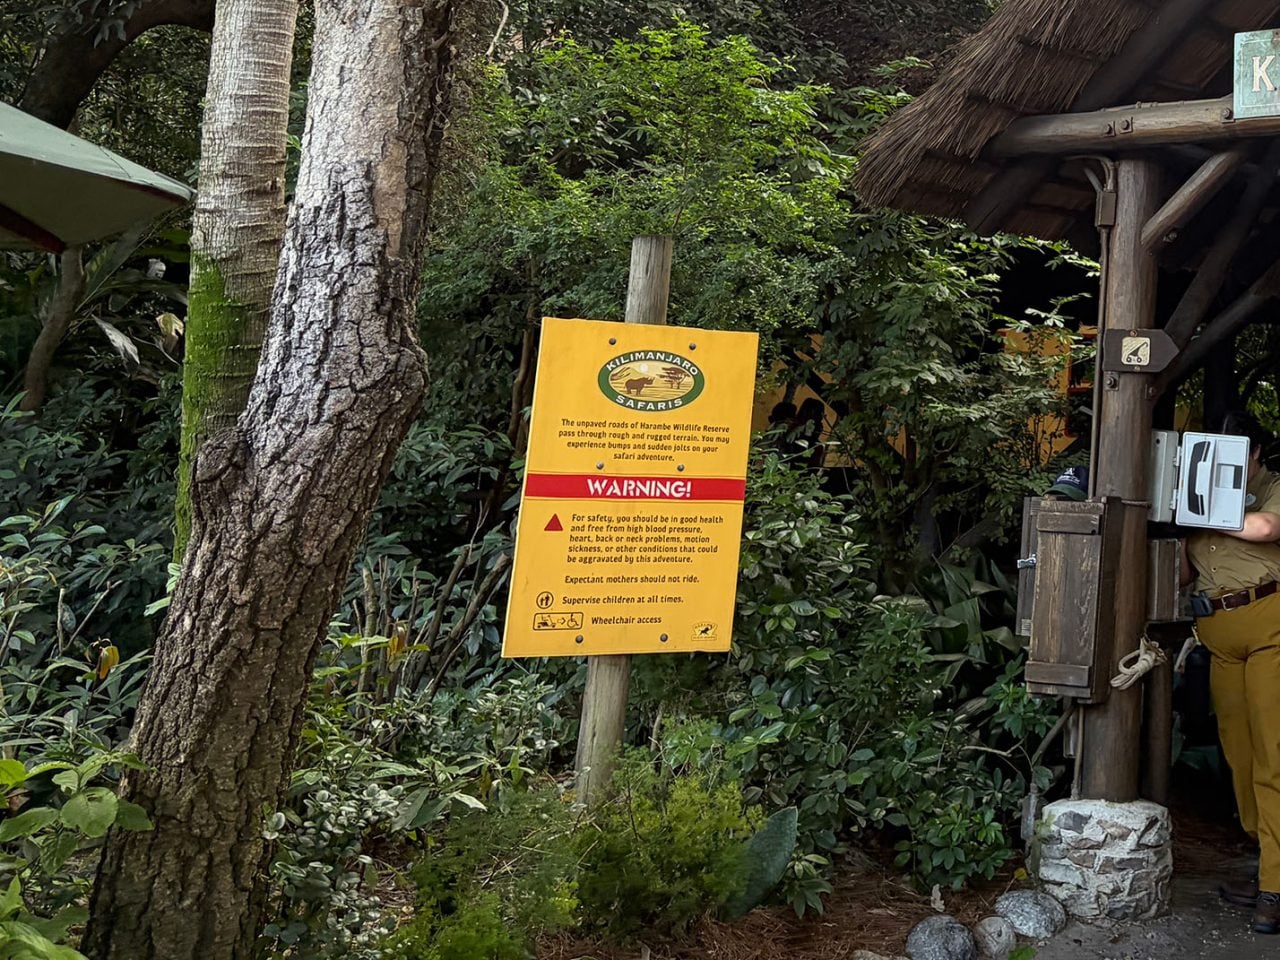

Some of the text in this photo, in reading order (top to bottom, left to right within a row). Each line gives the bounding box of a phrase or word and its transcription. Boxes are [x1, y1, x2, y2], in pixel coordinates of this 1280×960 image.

[606, 351, 698, 375] KILIMANJARO
[616, 395, 682, 410] SAFARIS
[576, 420, 606, 428] unpaved
[640, 422, 671, 430] Harambe
[673, 424, 701, 432] Wildlife
[703, 425, 730, 433] Reserve
[559, 430, 575, 438] pass
[577, 430, 606, 438] through
[609, 432, 629, 440] rough
[716, 436, 730, 444] may
[567, 441, 606, 449] experience
[608, 442, 630, 450] bumps
[648, 443, 672, 451] sudden
[673, 444, 690, 452] jolts
[587, 479, 691, 497] WARNING!
[572, 514, 585, 522] For
[633, 515, 658, 523] should
[660, 515, 669, 523] be
[680, 516, 697, 524] good
[627, 525, 643, 533] high
[668, 526, 702, 534] pressure,
[645, 536, 682, 544] problems,
[578, 555, 622, 564] aggravated
[625, 555, 633, 564] by
[565, 576, 603, 584] Expectant
[683, 575, 699, 583] ride.
[562, 596, 600, 604] Supervise
[602, 596, 635, 604] children
[591, 616, 635, 624] Wheelchair
